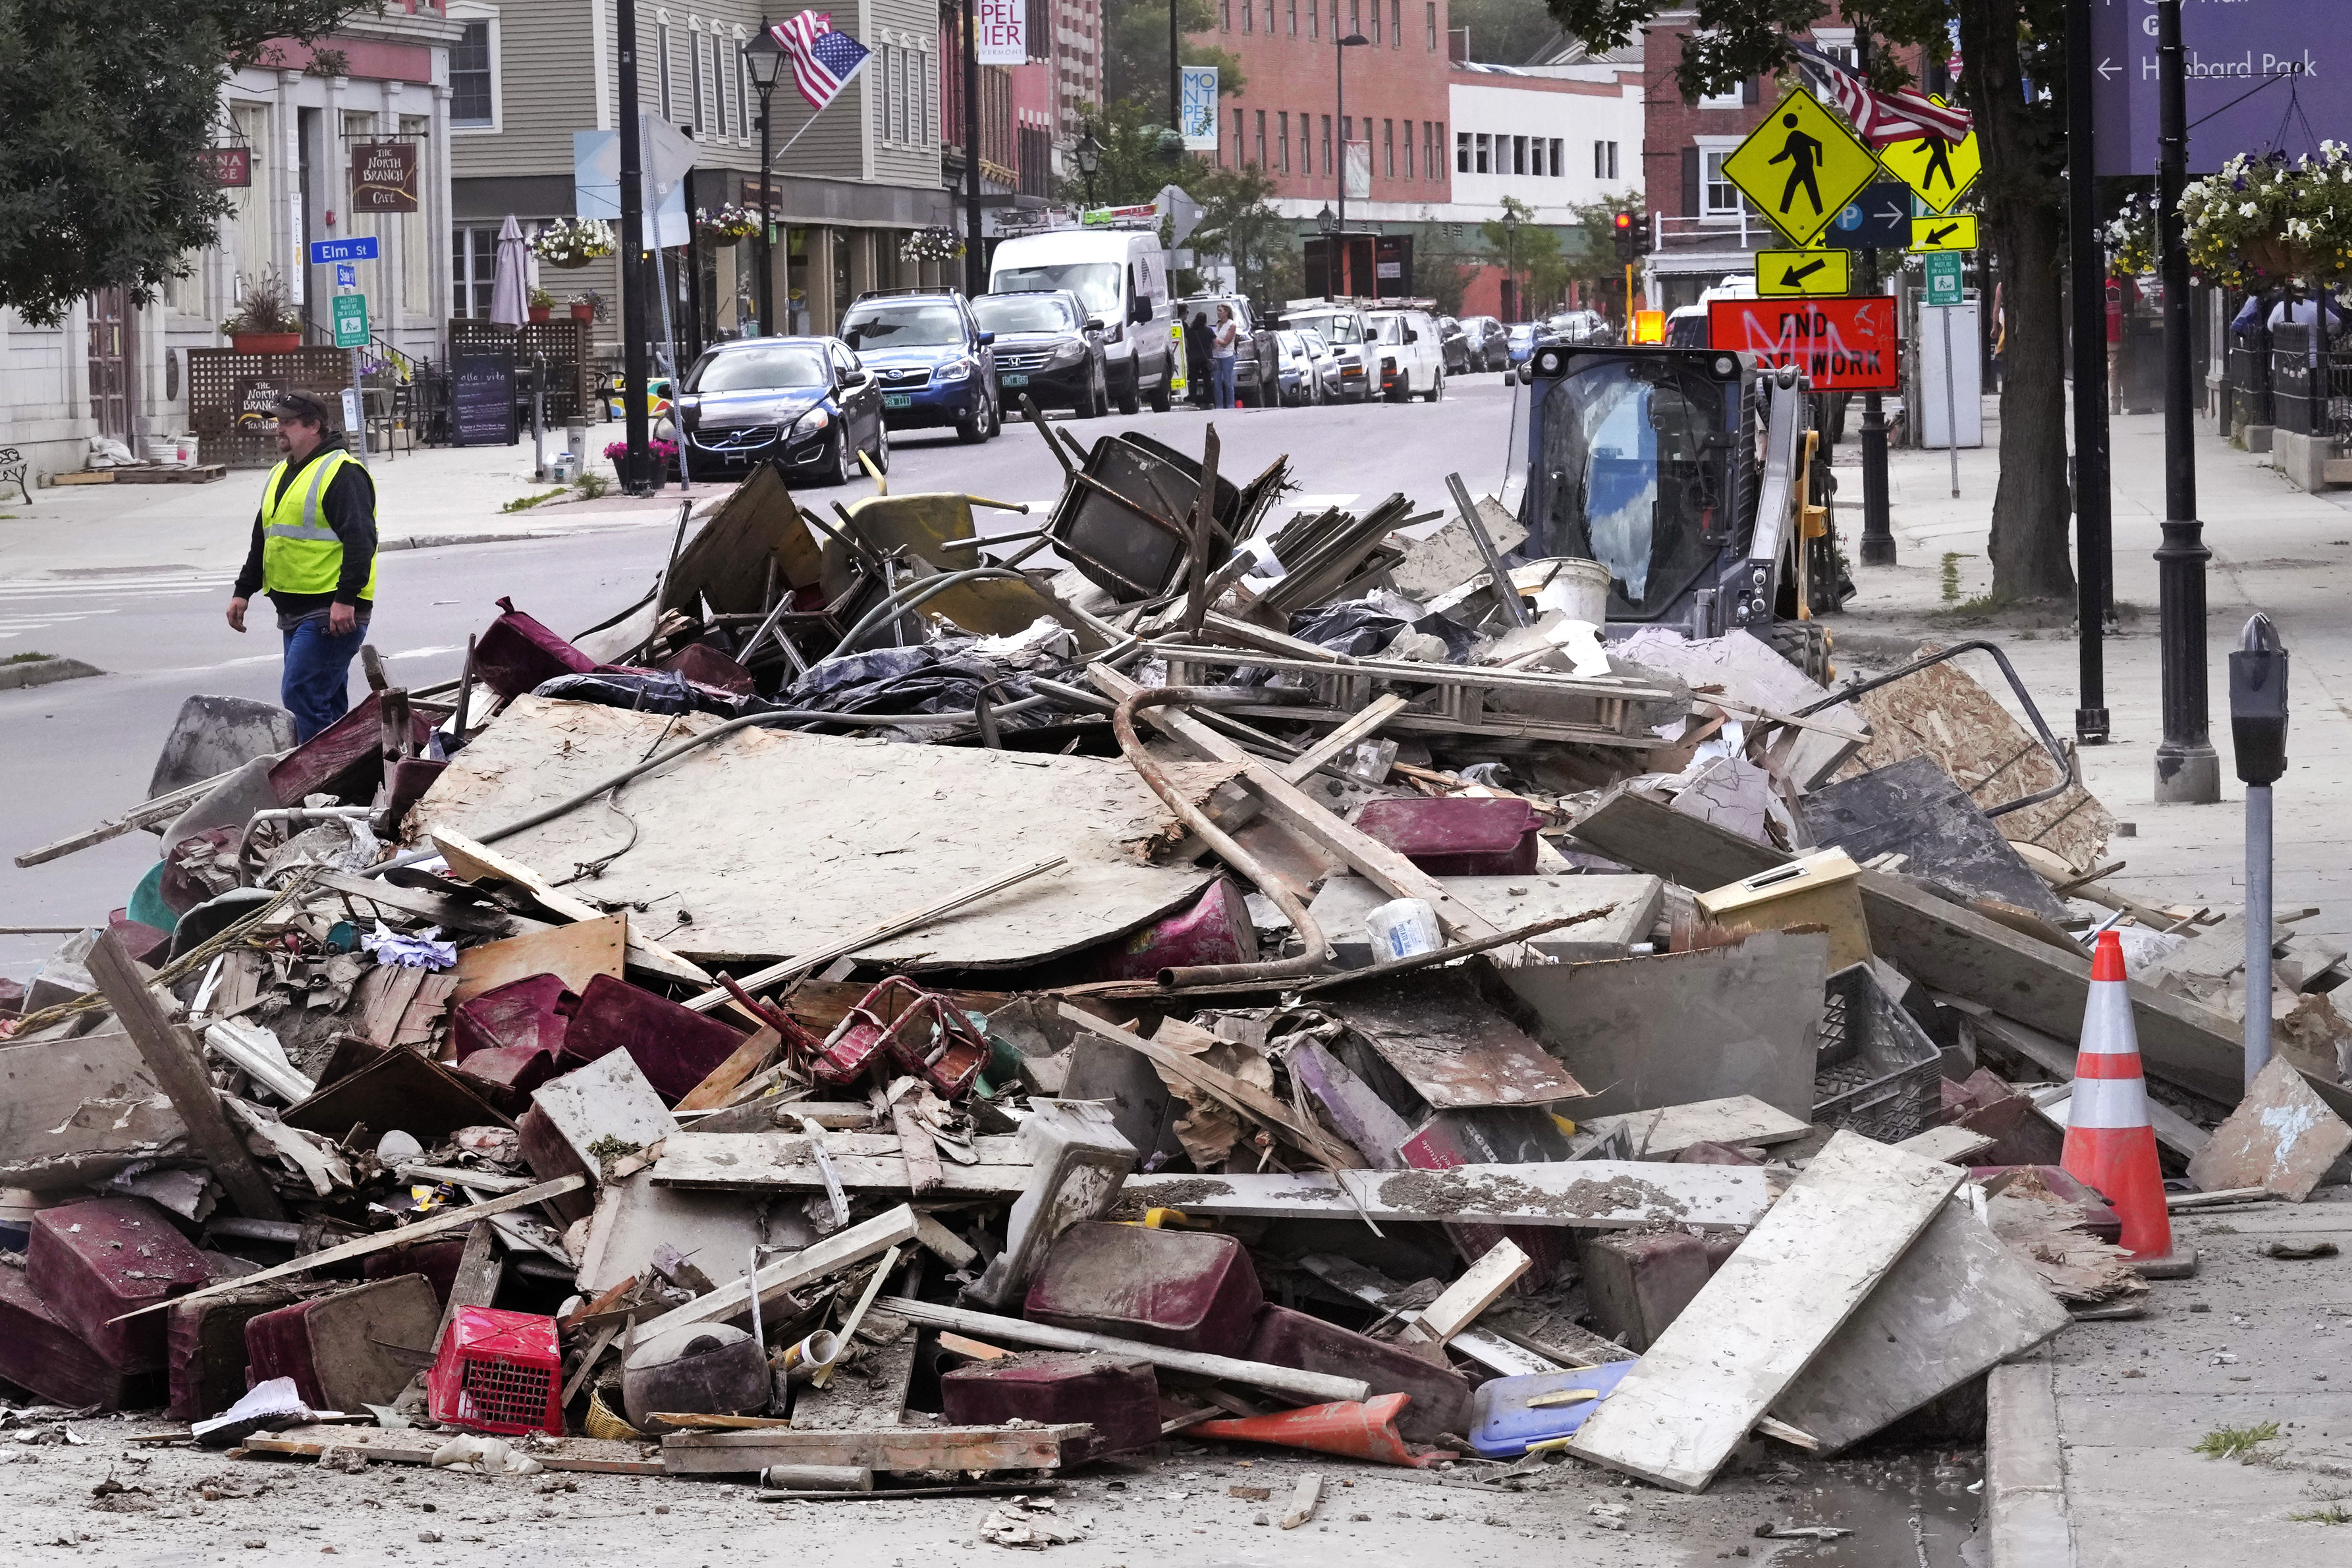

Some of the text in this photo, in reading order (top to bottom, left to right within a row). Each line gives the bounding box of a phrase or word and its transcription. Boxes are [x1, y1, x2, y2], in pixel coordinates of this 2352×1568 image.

[2143, 51, 2251, 80] Hbard
[1184, 73, 1215, 88] MO
[1184, 89, 1215, 104] NT
[1184, 105, 1215, 120] PE
[376, 149, 393, 157] THE
[368, 157, 401, 169] NORTH
[363, 169, 403, 182] BRANCH
[1842, 206, 1857, 228] P
[322, 245, 368, 259] Elm St
[1780, 313, 1827, 338] END
[1811, 350, 1882, 376] WORK
[243, 400, 274, 410] BRANC
[245, 420, 258, 429] TEA
[1397, 923, 1408, 942] POTATO
[1421, 1139, 1444, 1170] vitude
